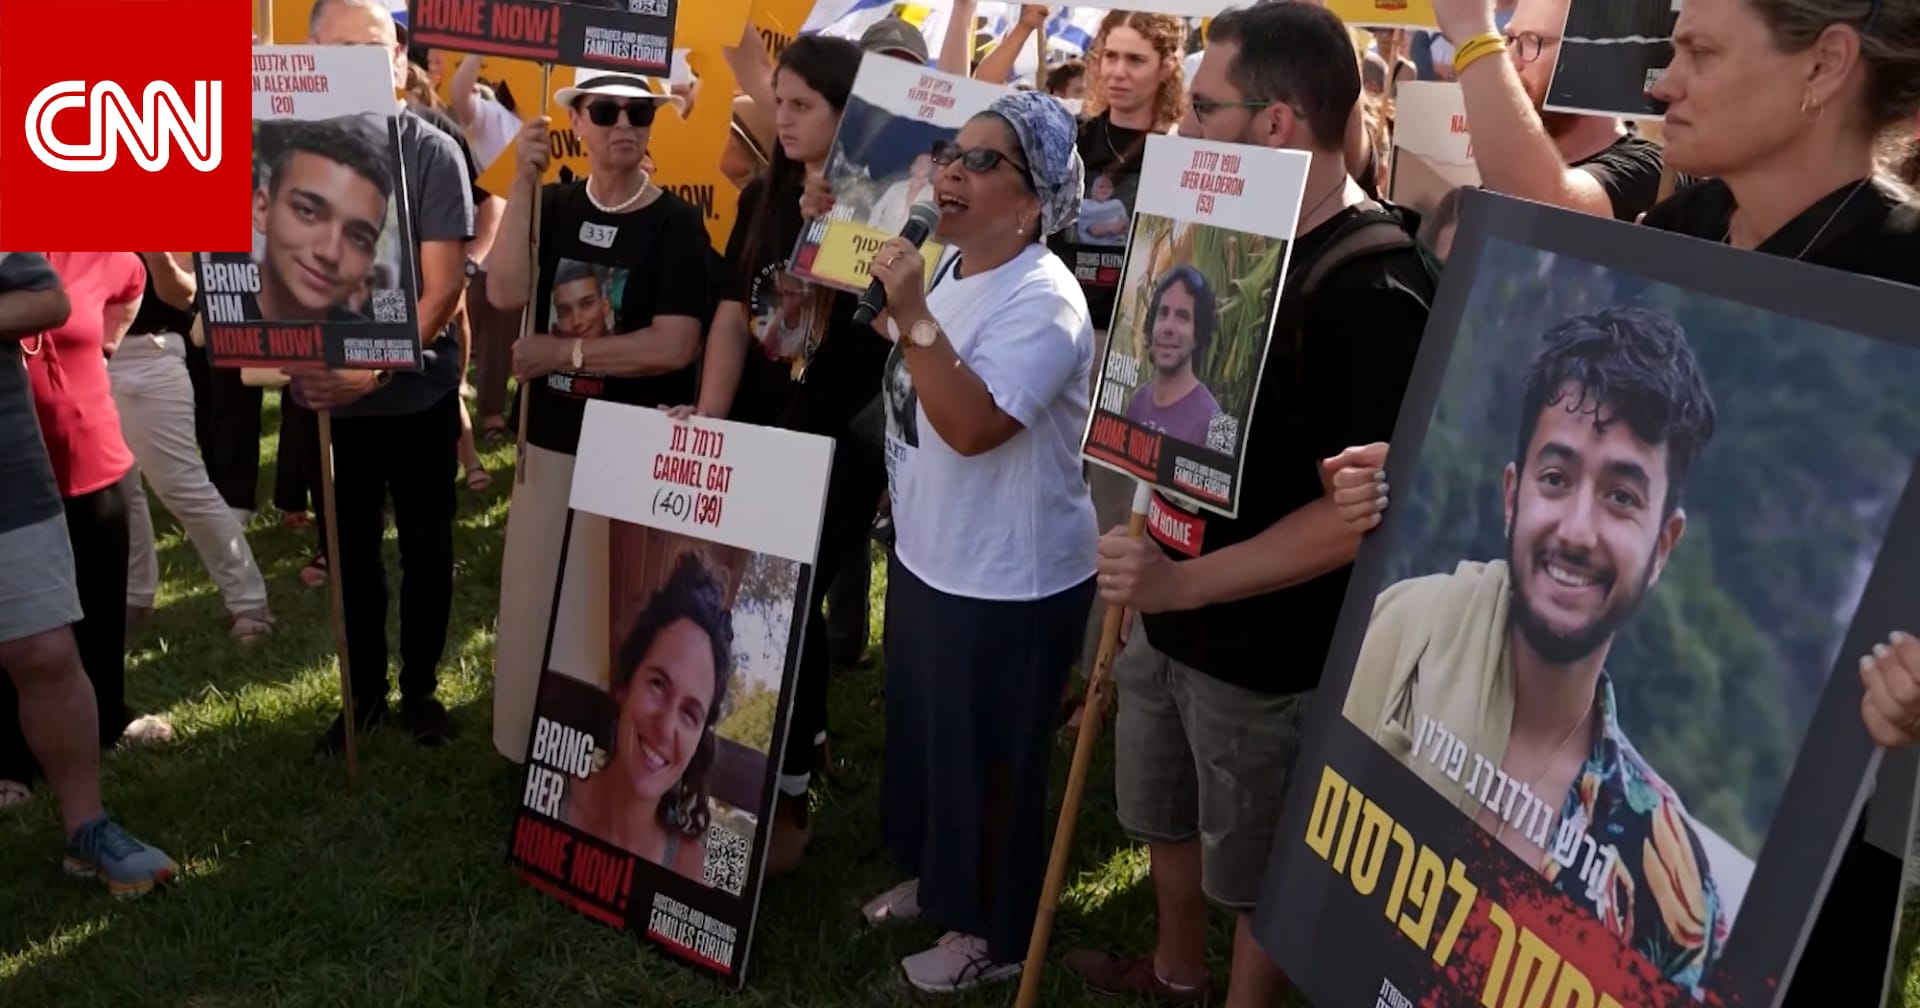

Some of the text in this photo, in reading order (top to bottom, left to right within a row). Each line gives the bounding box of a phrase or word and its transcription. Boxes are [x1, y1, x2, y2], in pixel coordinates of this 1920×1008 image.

[416, 0, 561, 45] HOME NOW!
[252, 54, 289, 73] אלכסנ
[583, 38, 667, 65] FAMILIES FORUM
[264, 75, 329, 94] ALEXANDER
[271, 96, 295, 116] (20)
[550, 129, 588, 159] OW.
[1181, 170, 1245, 197] OFER KALDERON
[1196, 193, 1215, 215] (53)
[202, 263, 260, 293] BRING
[206, 295, 245, 323] HIM
[211, 325, 324, 357] HOME NOW!
[1105, 350, 1140, 388] BRING
[1100, 380, 1124, 415] HIM
[669, 425, 725, 460] כרמל גת
[1092, 415, 1163, 469] HOME NOW!
[653, 454, 734, 493] CARMEL GAT
[652, 488, 692, 523] (40)
[1159, 511, 1193, 546] HOME
[532, 716, 595, 781] BRING
[1410, 713, 1468, 780] פולין
[523, 764, 565, 820] HER
[1464, 750, 1555, 851] גולדברג
[512, 814, 637, 911] HOME NOW!
[1305, 765, 1478, 968] לפרסום
[648, 908, 735, 969] FAMILIES FORUM
